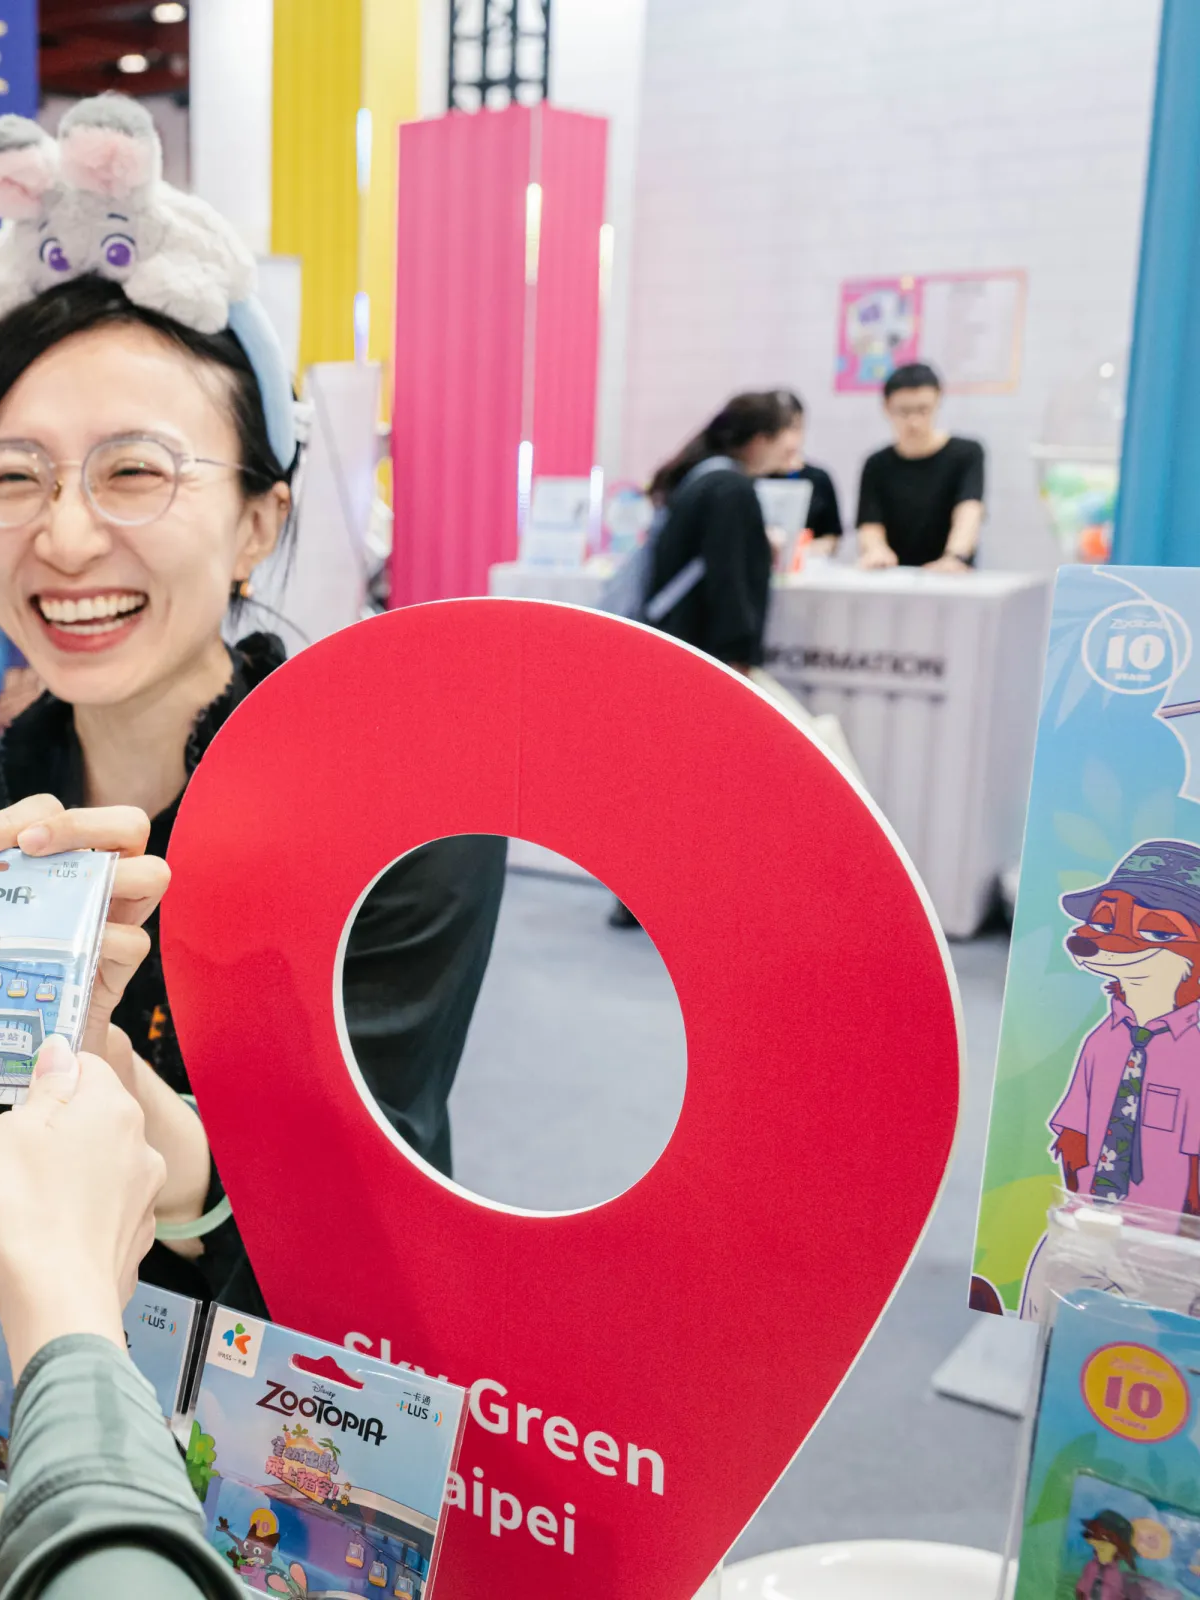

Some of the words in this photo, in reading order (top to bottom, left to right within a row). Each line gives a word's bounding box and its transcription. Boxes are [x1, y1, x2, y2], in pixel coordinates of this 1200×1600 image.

[765, 647, 946, 676] FORMATION
[1106, 634, 1166, 670] 10
[144, 1303, 169, 1317] 一卡通
[312, 1381, 336, 1399] Disney
[403, 1391, 431, 1406] 一卡通
[1104, 1375, 1164, 1419] 10
[256, 1379, 387, 1447] ZOOTOPIA
[271, 1436, 339, 1475] 全城出動
[468, 1378, 665, 1496] Green
[444, 1467, 576, 1556] aipei
